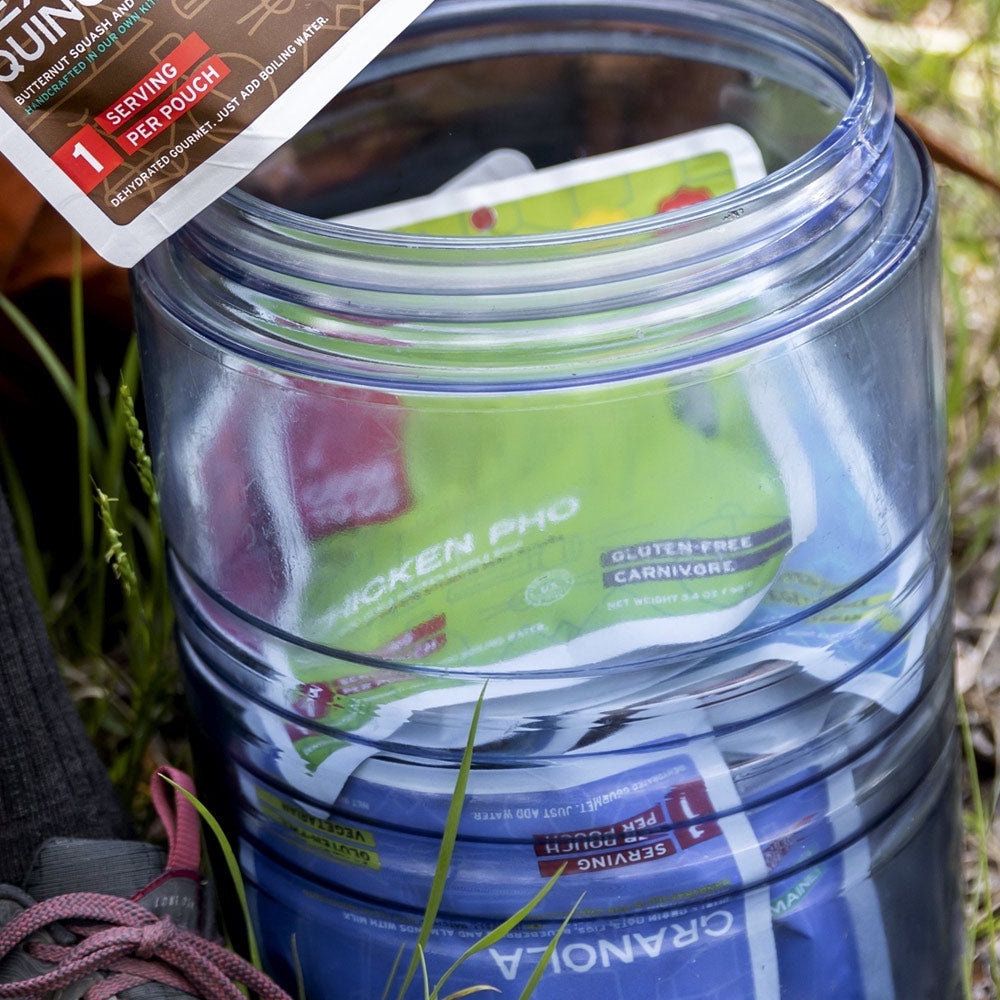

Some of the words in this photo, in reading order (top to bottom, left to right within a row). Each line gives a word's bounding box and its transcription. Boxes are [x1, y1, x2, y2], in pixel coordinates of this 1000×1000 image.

[14, 56, 70, 106] BUTTERNUT
[69, 18, 113, 59] SQUASH
[24, 60, 87, 116] HANDCRAFTED
[88, 51, 99, 64] IN
[97, 32, 119, 53] OUR
[117, 11, 141, 34] OWN
[72, 142, 105, 174] 1
[126, 116, 163, 147] PER
[159, 65, 221, 122] POUCH
[106, 62, 178, 126] SERVING
[110, 155, 170, 209] DEHYDRATED
[168, 120, 217, 158] GOURMET.
[215, 97, 240, 121] JUST
[240, 78, 261, 99] ADD
[258, 45, 297, 82] BOILING
[294, 15, 330, 49] WATER.
[489, 497, 581, 545] PHO
[614, 560, 736, 584] CARNIVORE
[516, 808, 539, 819] ADD
[543, 805, 573, 818] JUST
[577, 843, 668, 871] SERVING
[400, 924, 454, 937] ALMNDS
[489, 910, 734, 980] GRANOLA
